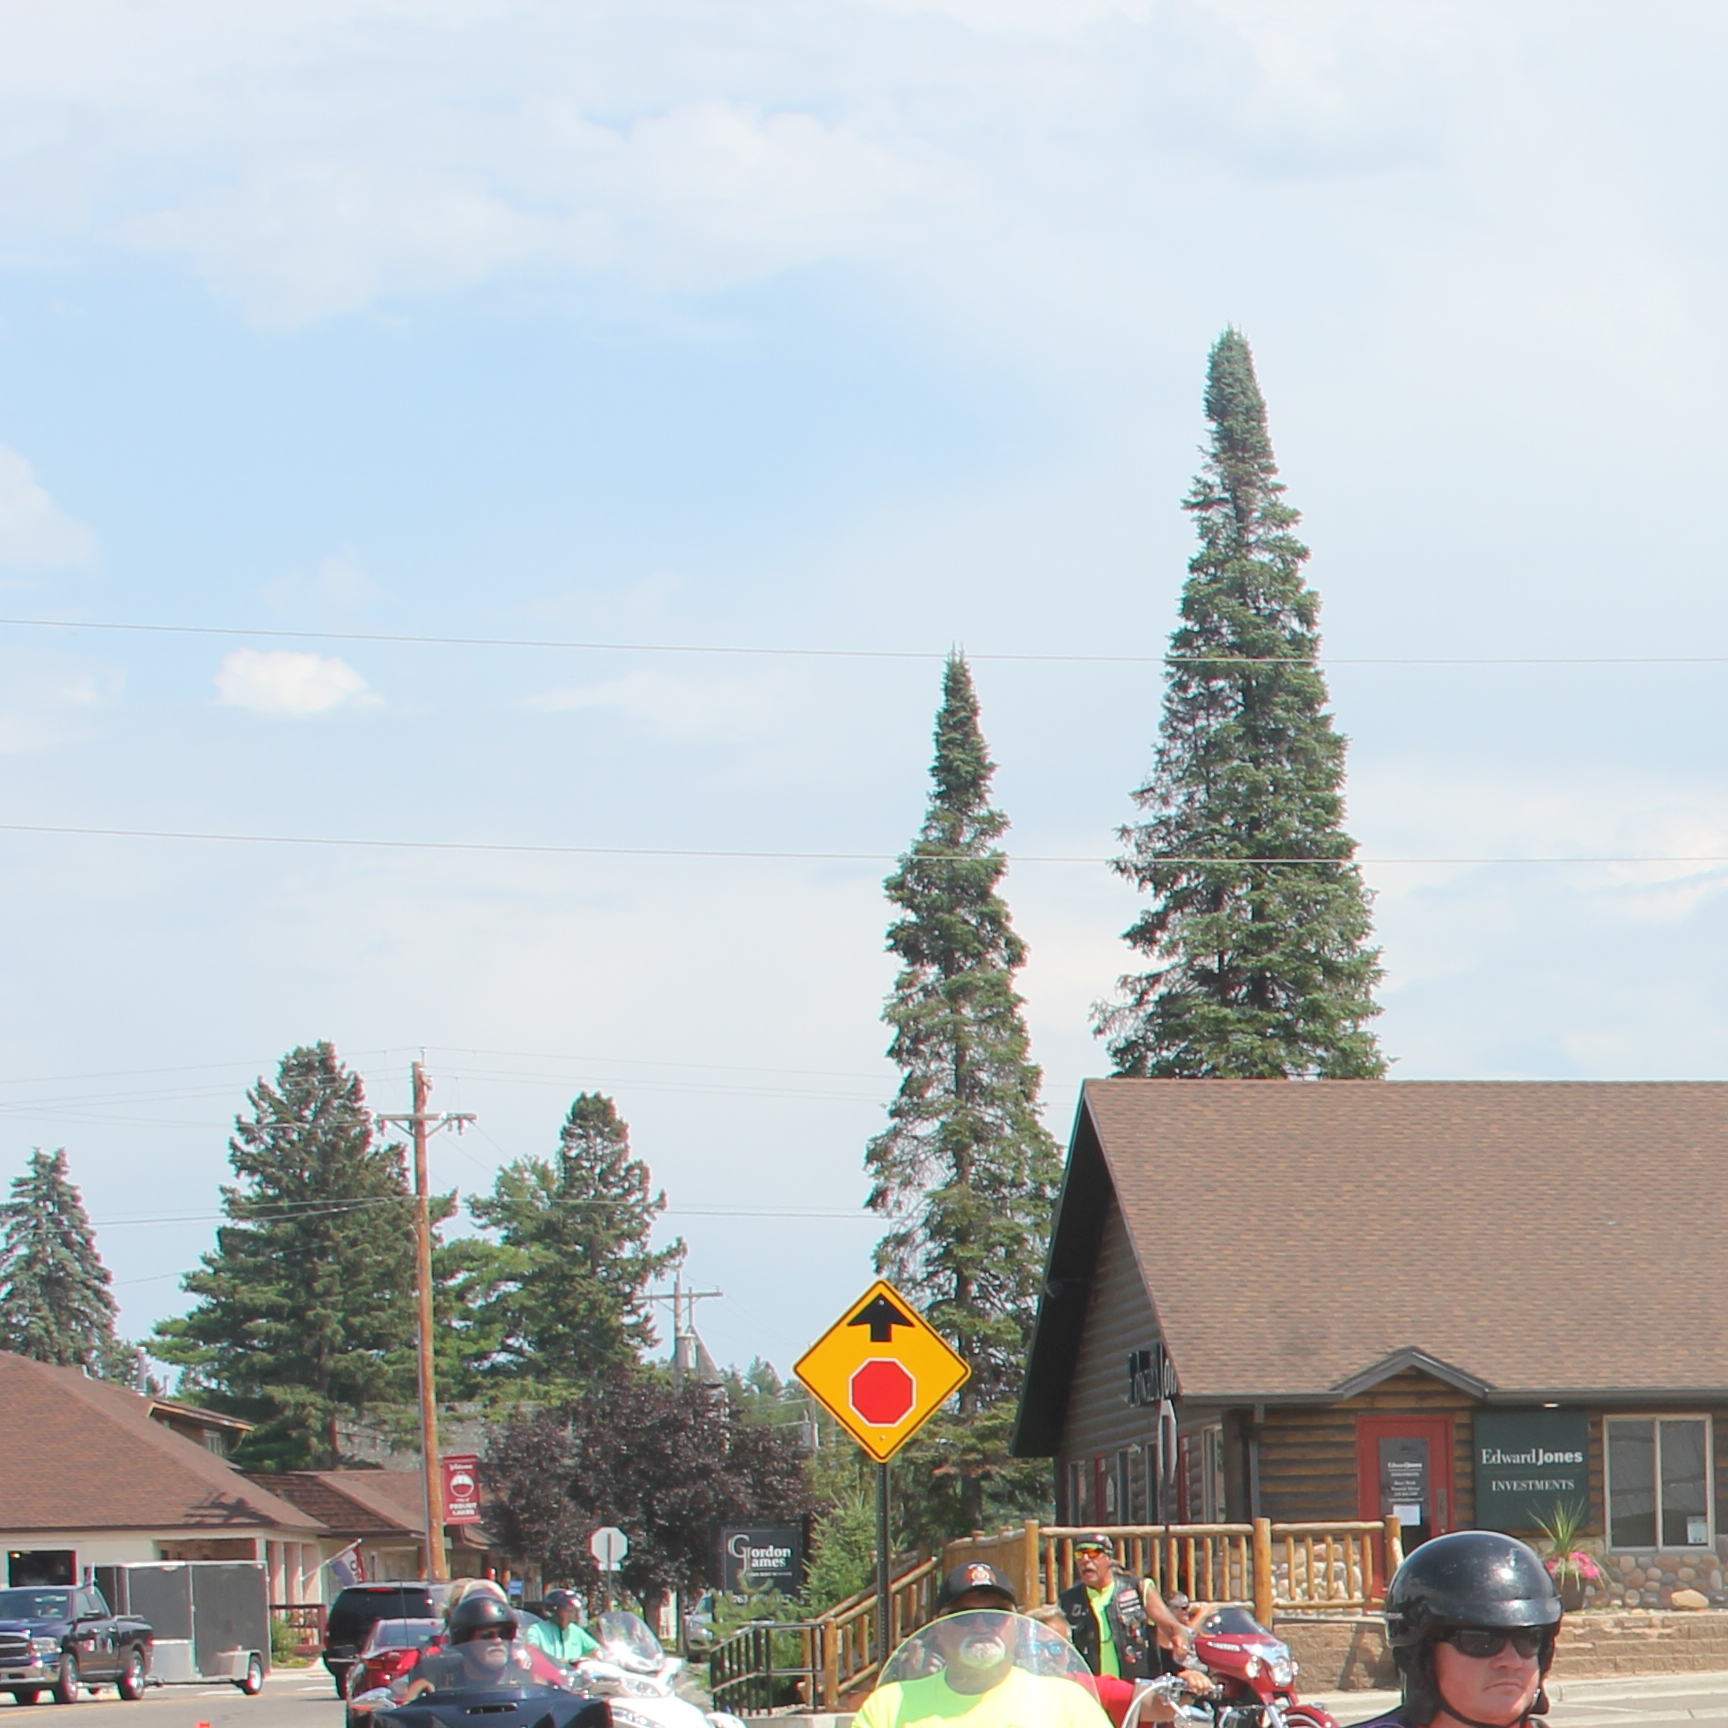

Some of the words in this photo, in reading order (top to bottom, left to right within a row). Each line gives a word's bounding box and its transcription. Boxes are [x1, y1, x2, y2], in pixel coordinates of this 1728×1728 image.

[1481, 1448, 1535, 1465] Edward
[1537, 1448, 1584, 1466] Jones
[1492, 1480, 1575, 1492] INVESTMENTS
[728, 1534, 792, 1558] Gordon
